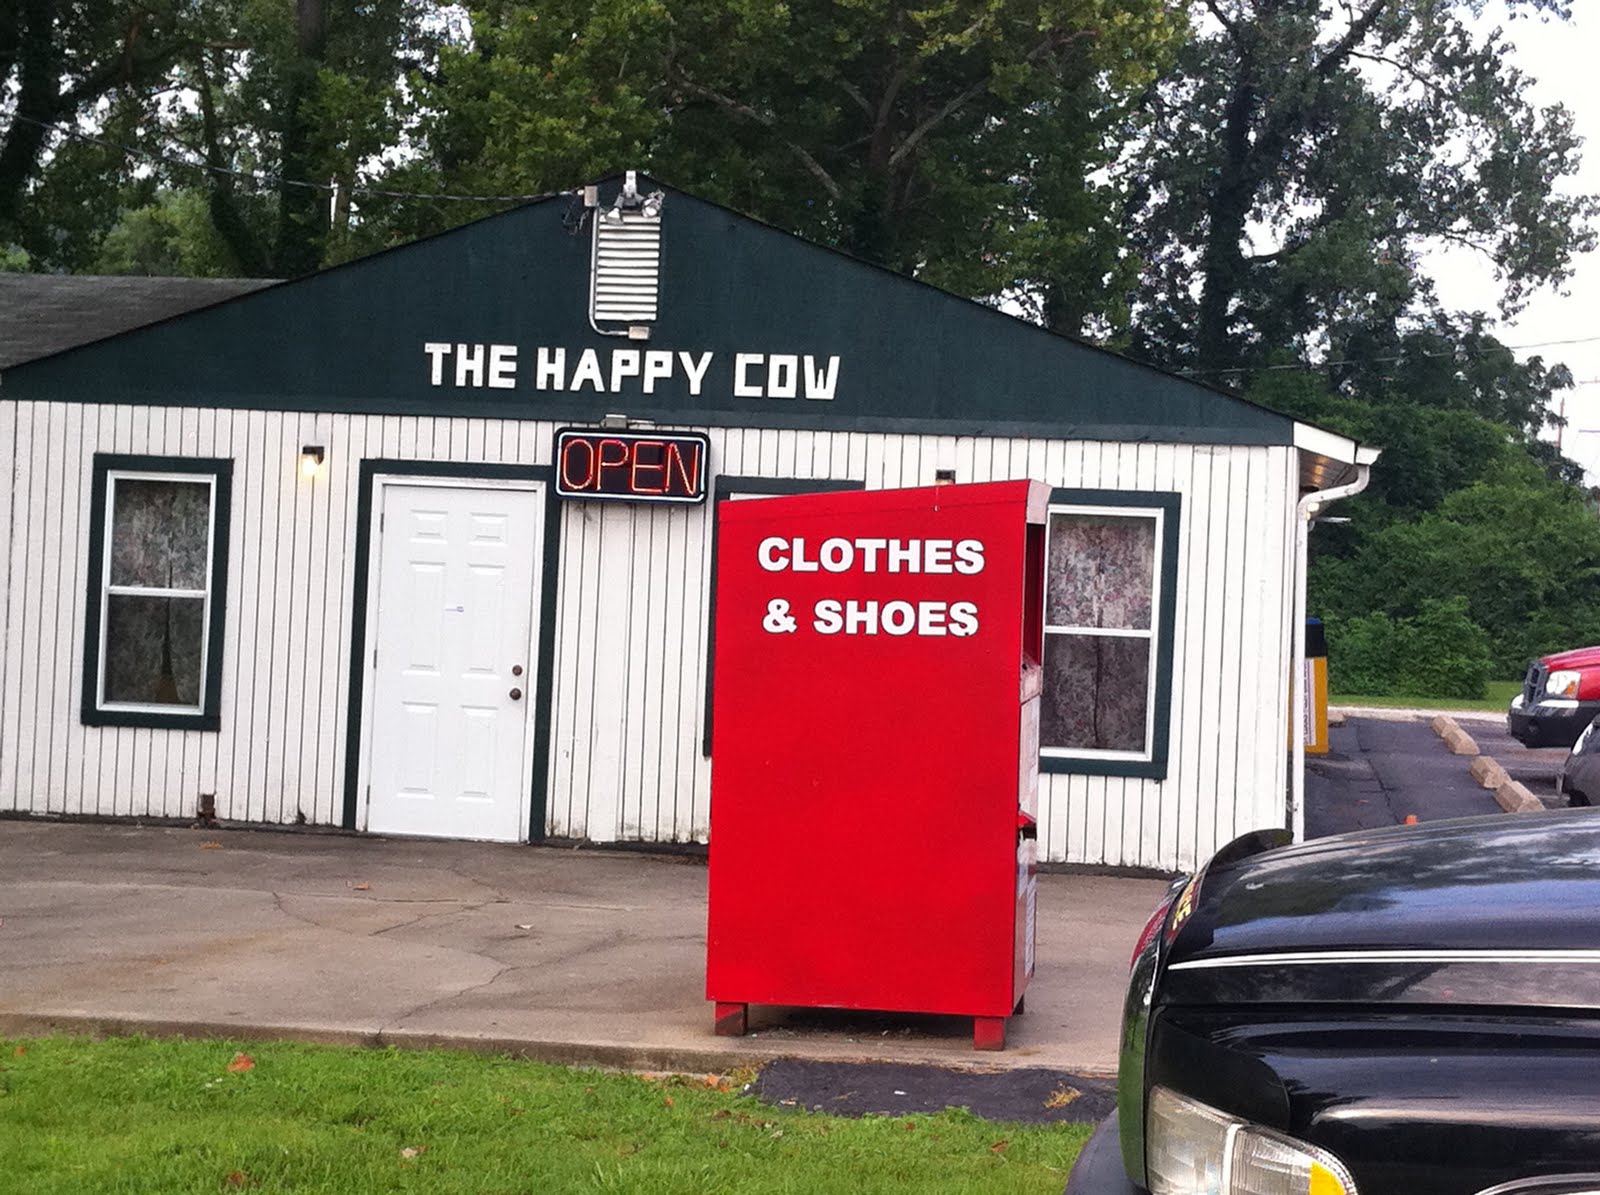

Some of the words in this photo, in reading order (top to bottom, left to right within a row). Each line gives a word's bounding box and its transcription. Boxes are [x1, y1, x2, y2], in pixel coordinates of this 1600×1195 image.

[424, 342, 518, 389] THE
[536, 347, 713, 396] HAPPY
[733, 352, 841, 400] COW
[561, 438, 700, 497] OPEN
[757, 536, 986, 575] CLOTHES
[762, 598, 797, 634] &
[813, 598, 980, 637] SHOES
